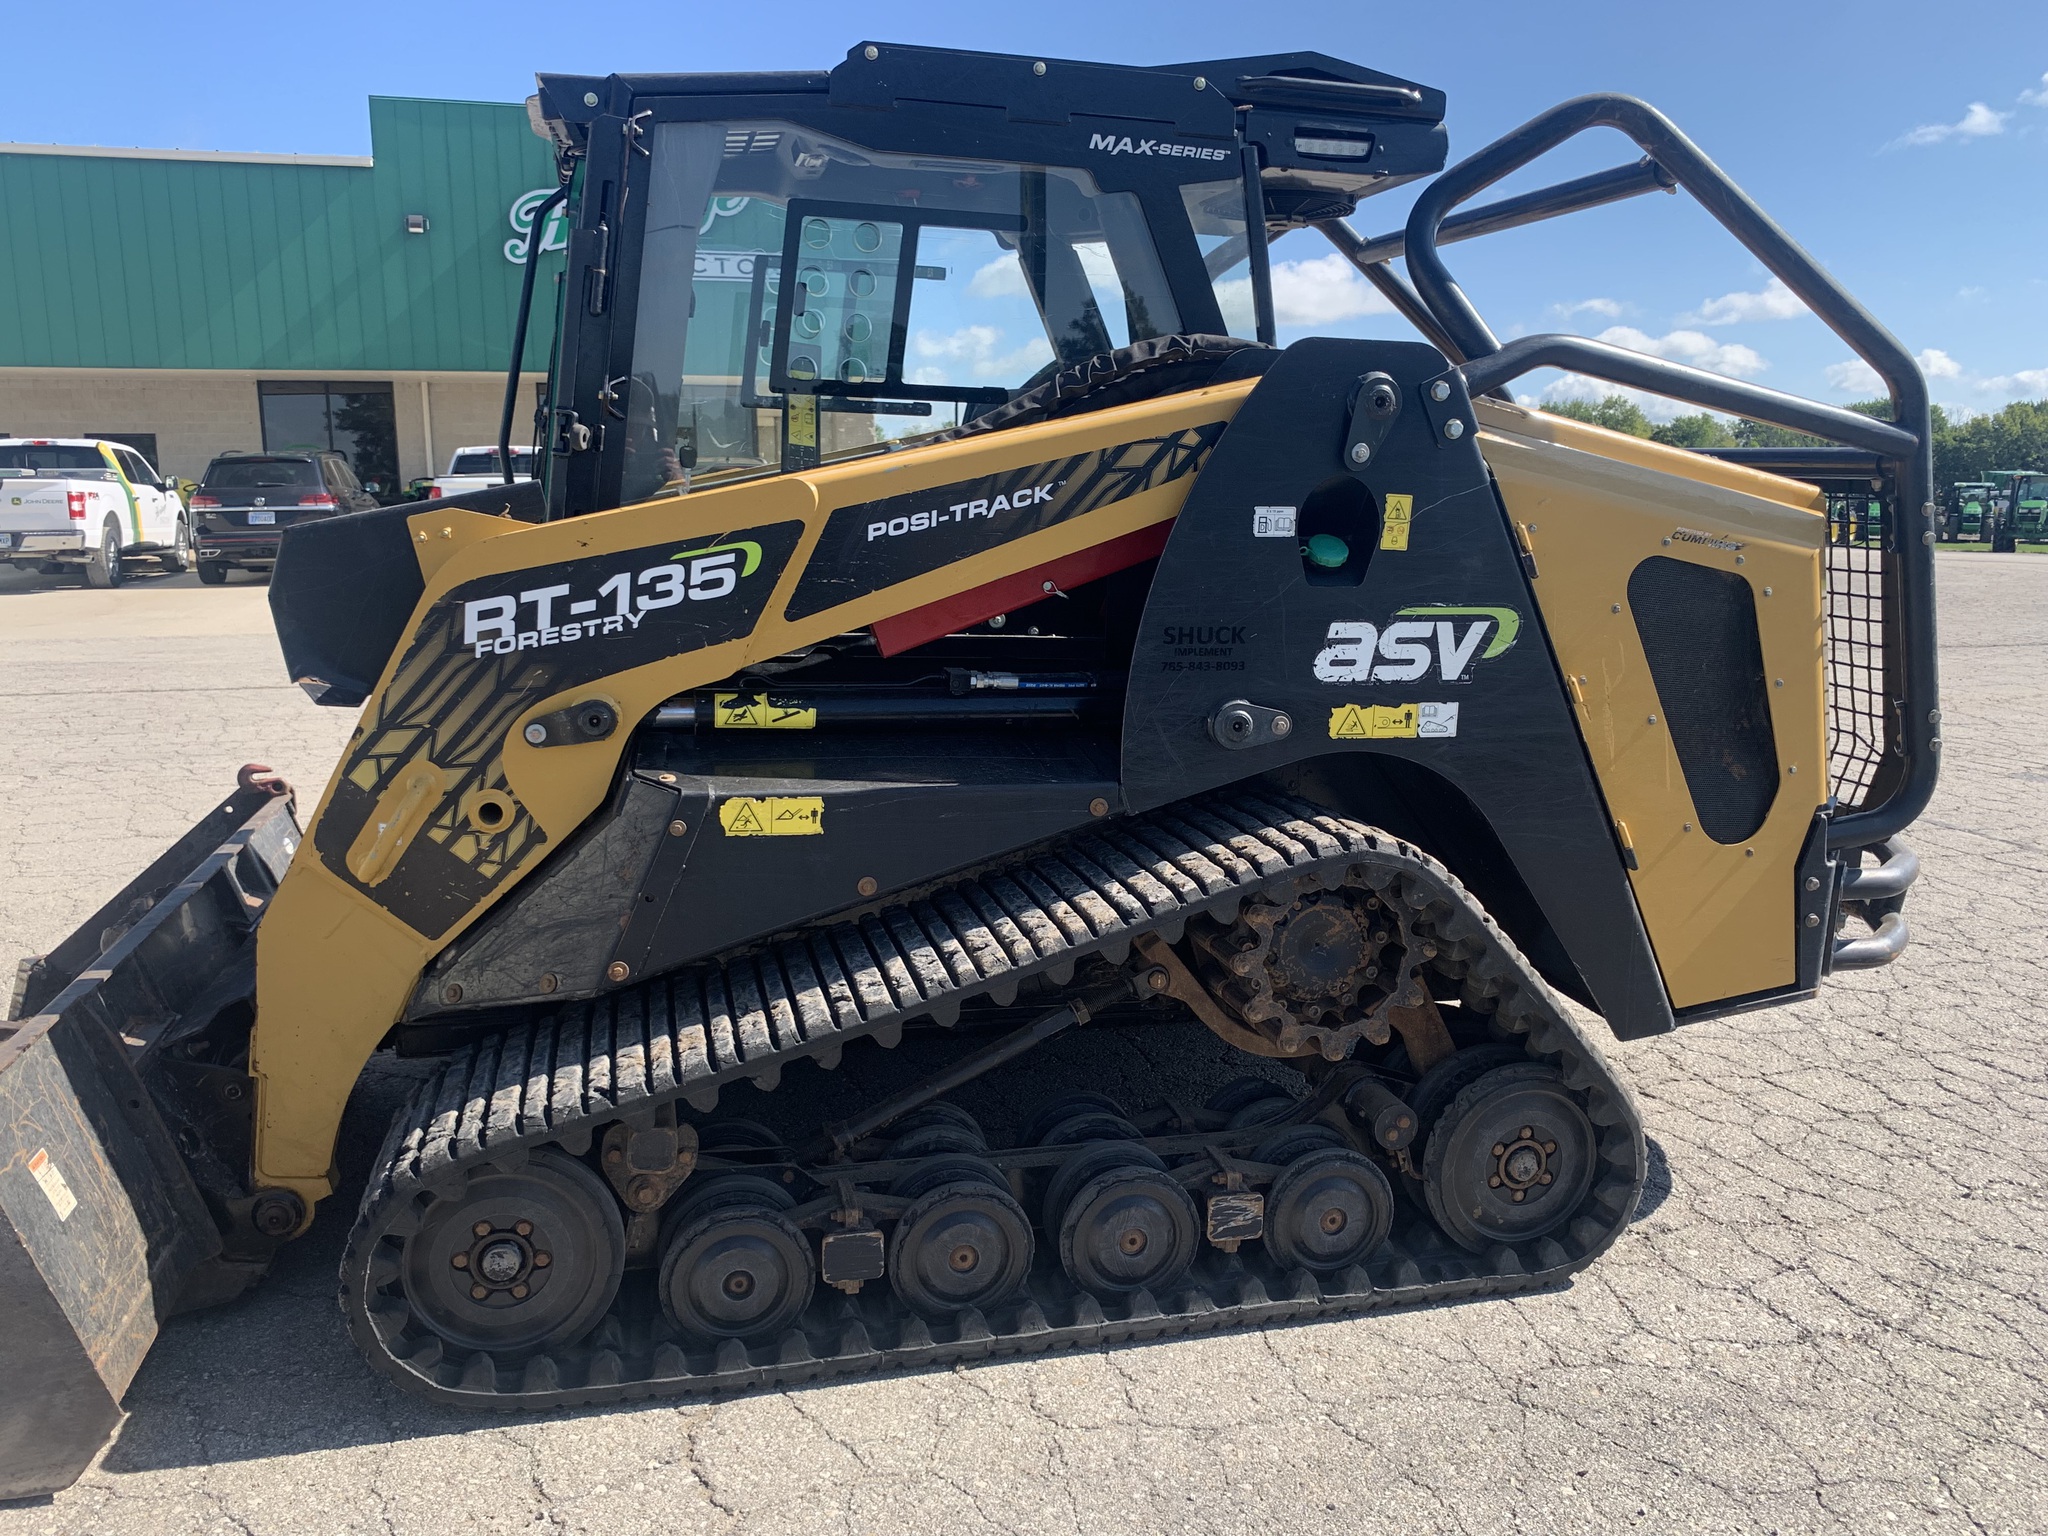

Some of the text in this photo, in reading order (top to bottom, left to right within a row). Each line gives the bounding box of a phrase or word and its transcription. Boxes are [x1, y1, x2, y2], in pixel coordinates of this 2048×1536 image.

[1088, 133, 1225, 161] MAX-SERIES
[866, 483, 1055, 542] POSI-TRACK
[463, 552, 737, 645] RT-135
[475, 609, 648, 659] FORESTRY
[1162, 626, 1246, 645] SHUCK
[1174, 647, 1234, 657] IMPLEMENT
[1160, 661, 1246, 672] 765-843-8093
